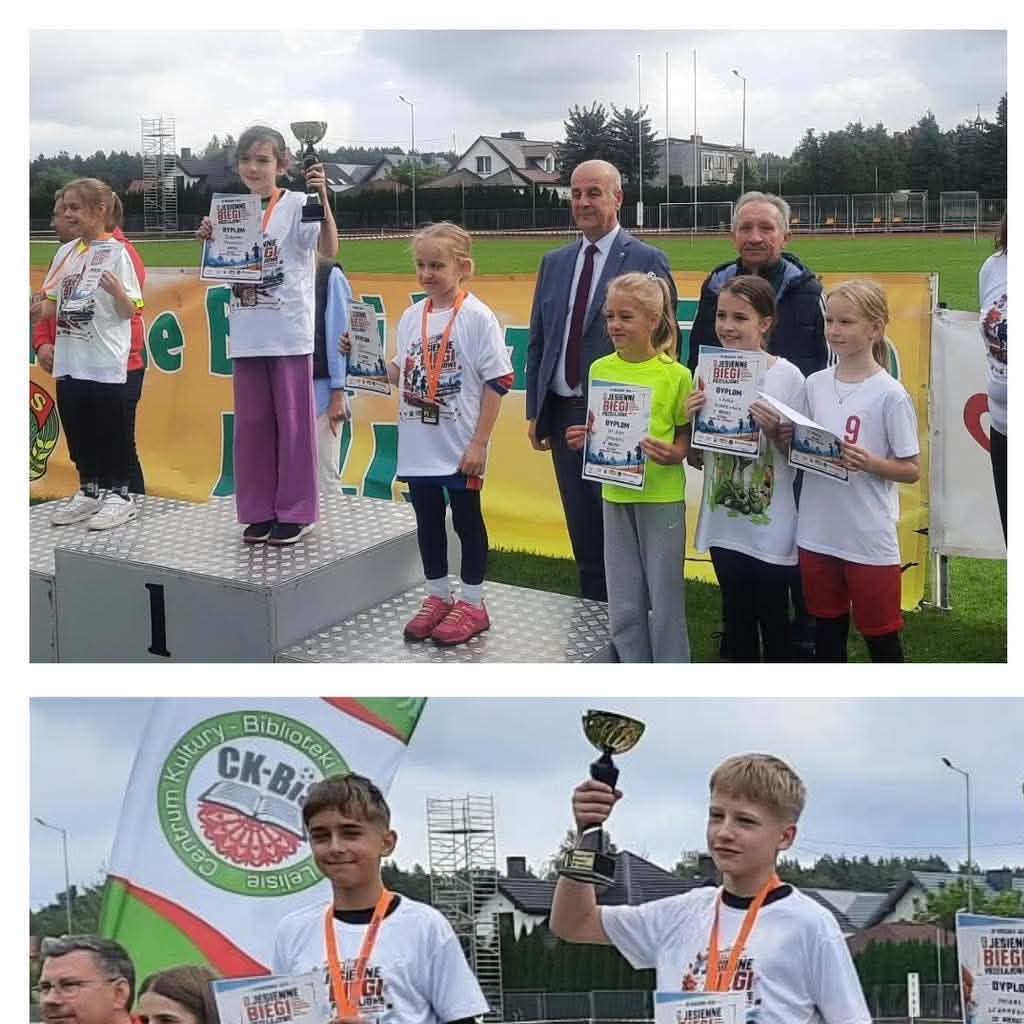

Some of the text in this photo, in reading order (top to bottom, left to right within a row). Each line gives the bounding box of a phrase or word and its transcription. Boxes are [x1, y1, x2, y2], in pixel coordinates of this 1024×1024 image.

[713, 367, 740, 379] BIEGI
[602, 401, 628, 412] BIEGI
[844, 415, 860, 444] 9
[145, 583, 171, 658] 1
[164, 724, 225, 784] Kultury
[242, 714, 338, 769] Biblioteki
[165, 789, 218, 876] Centrum
[247, 999, 291, 1021] BIEGI
[684, 1007, 722, 1019] JESIENNE
